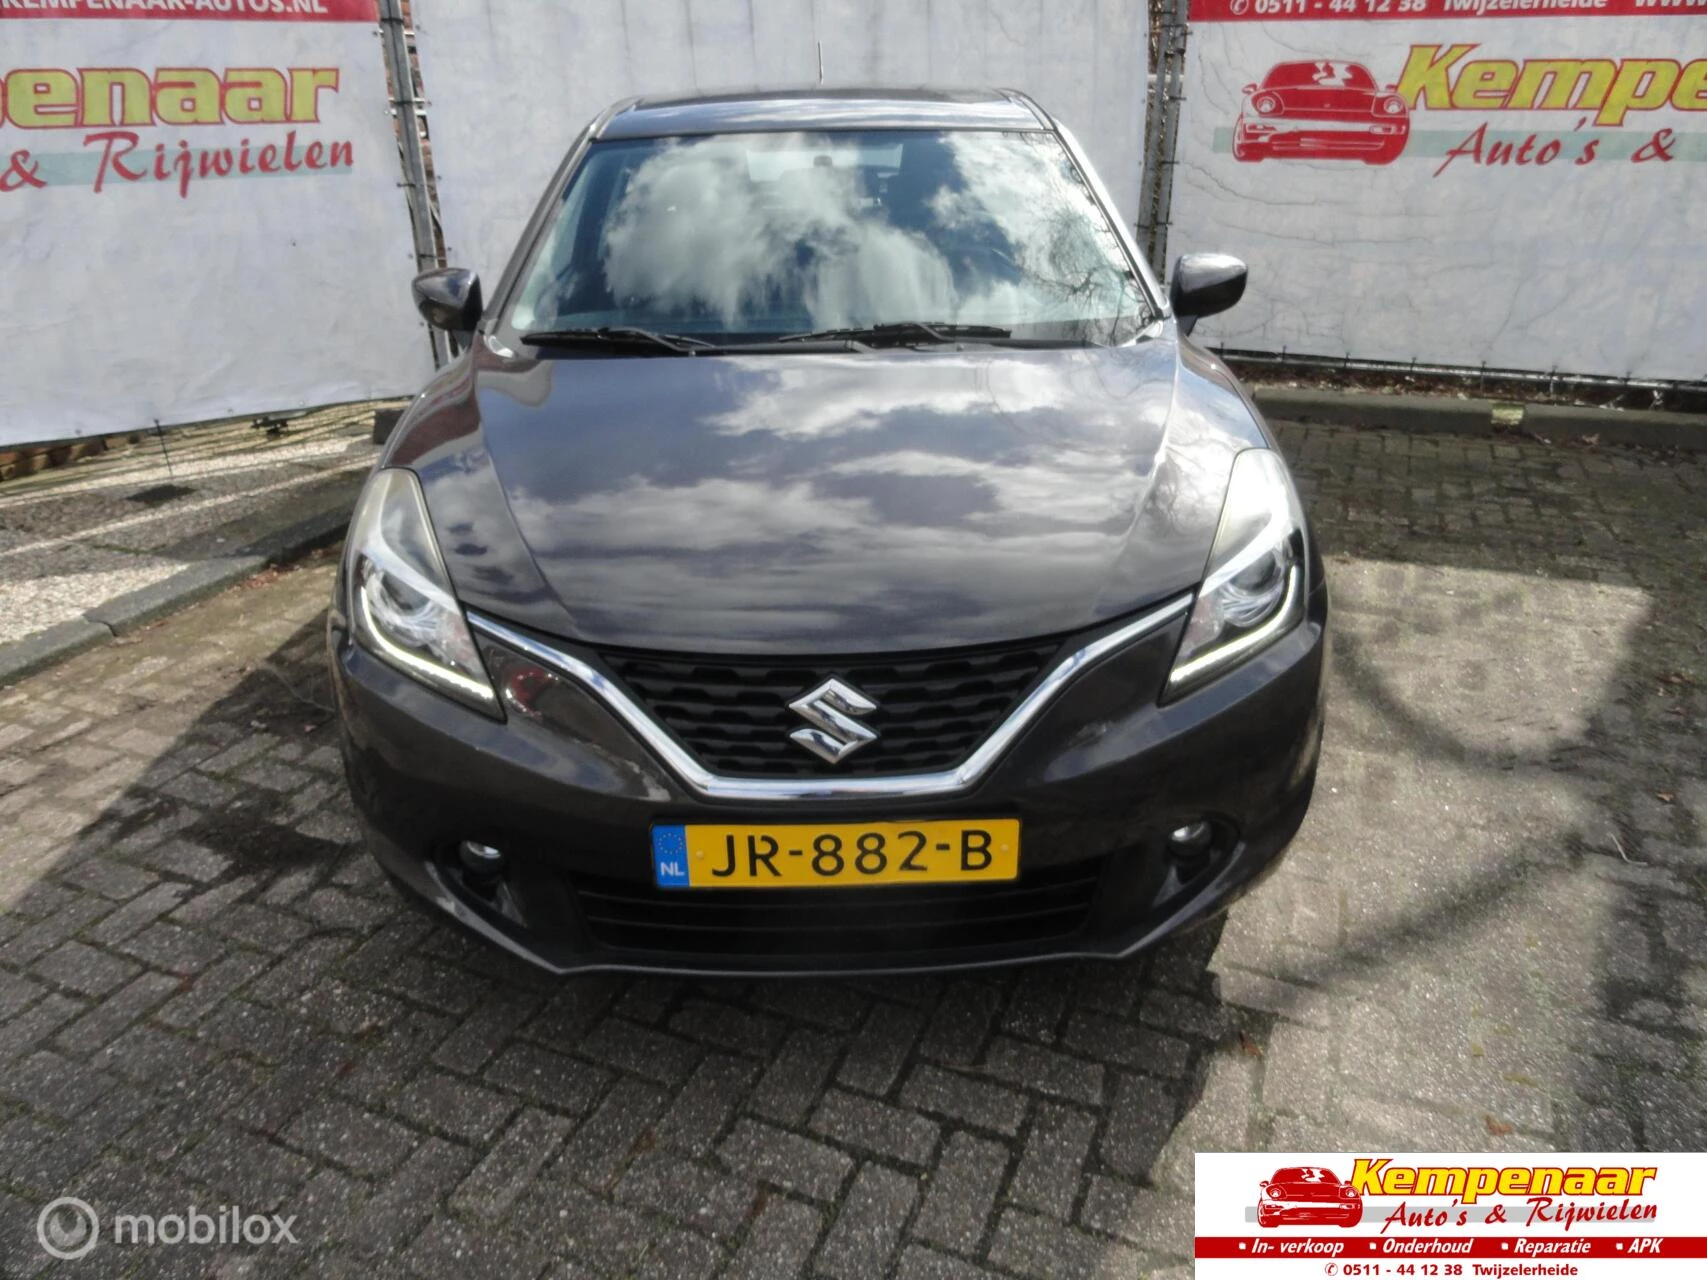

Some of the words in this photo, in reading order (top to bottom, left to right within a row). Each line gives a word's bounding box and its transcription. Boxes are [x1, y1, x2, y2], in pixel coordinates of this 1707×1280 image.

[0, 67, 339, 129] enaar
[0, 149, 47, 192] &
[83, 130, 354, 199] Rijwielen
[1433, 117, 1600, 178] Auto's
[1631, 127, 1676, 164] &
[660, 861, 684, 877] NL
[711, 829, 993, 877] JR-882-B
